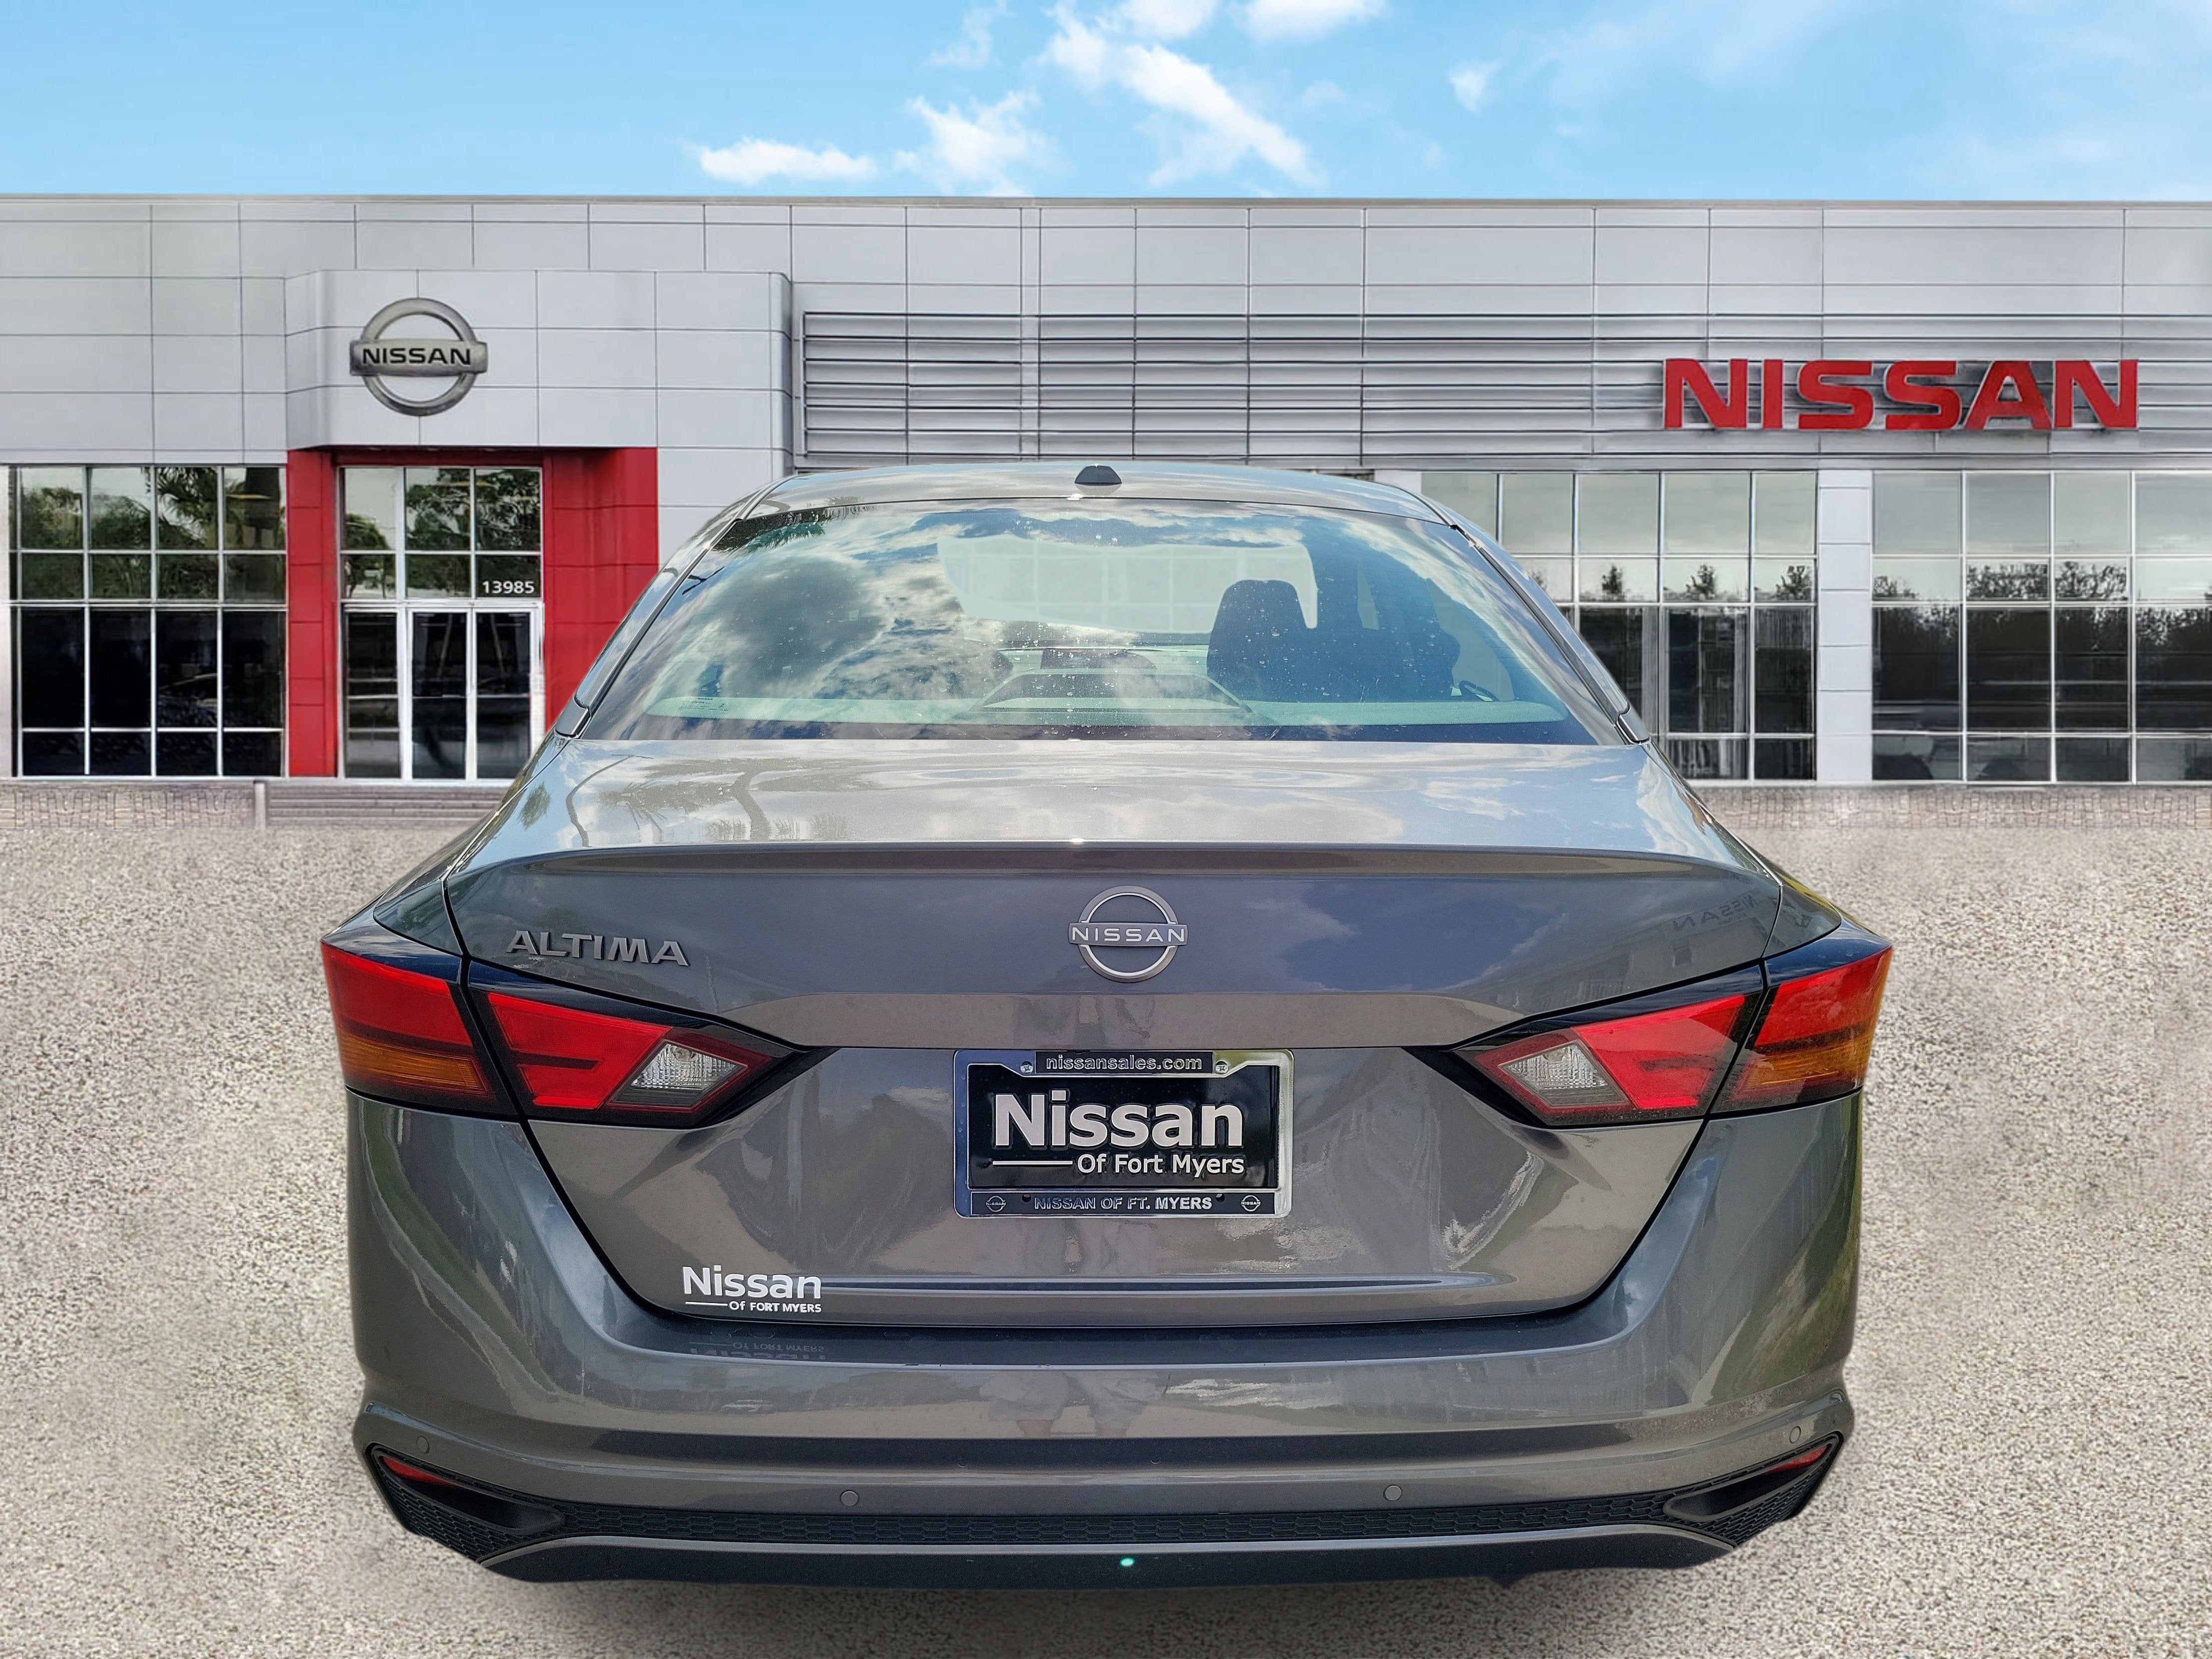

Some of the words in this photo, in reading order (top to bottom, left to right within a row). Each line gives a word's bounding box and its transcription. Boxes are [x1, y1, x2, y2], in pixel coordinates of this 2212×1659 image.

[363, 348, 471, 365] NISSAN
[1663, 358, 2138, 430] NISSAN
[482, 581, 535, 594] 13985
[1072, 927, 1184, 942] NISSAN
[506, 930, 690, 966] ALTIMA
[1046, 1055, 1203, 1070] nissansales.com
[995, 1090, 1243, 1147] Nissan
[1077, 1153, 1107, 1173] Of
[1115, 1154, 1163, 1173] Fort
[1172, 1154, 1244, 1178] Myers
[1034, 1197, 1096, 1209] NISSAN
[1101, 1197, 1123, 1209] OF
[1127, 1197, 1150, 1209] FT.
[1155, 1197, 1212, 1209] MYERS
[683, 1265, 821, 1299] Nissan
[750, 1302, 780, 1312] FORT
[782, 1303, 821, 1313] MYERS
